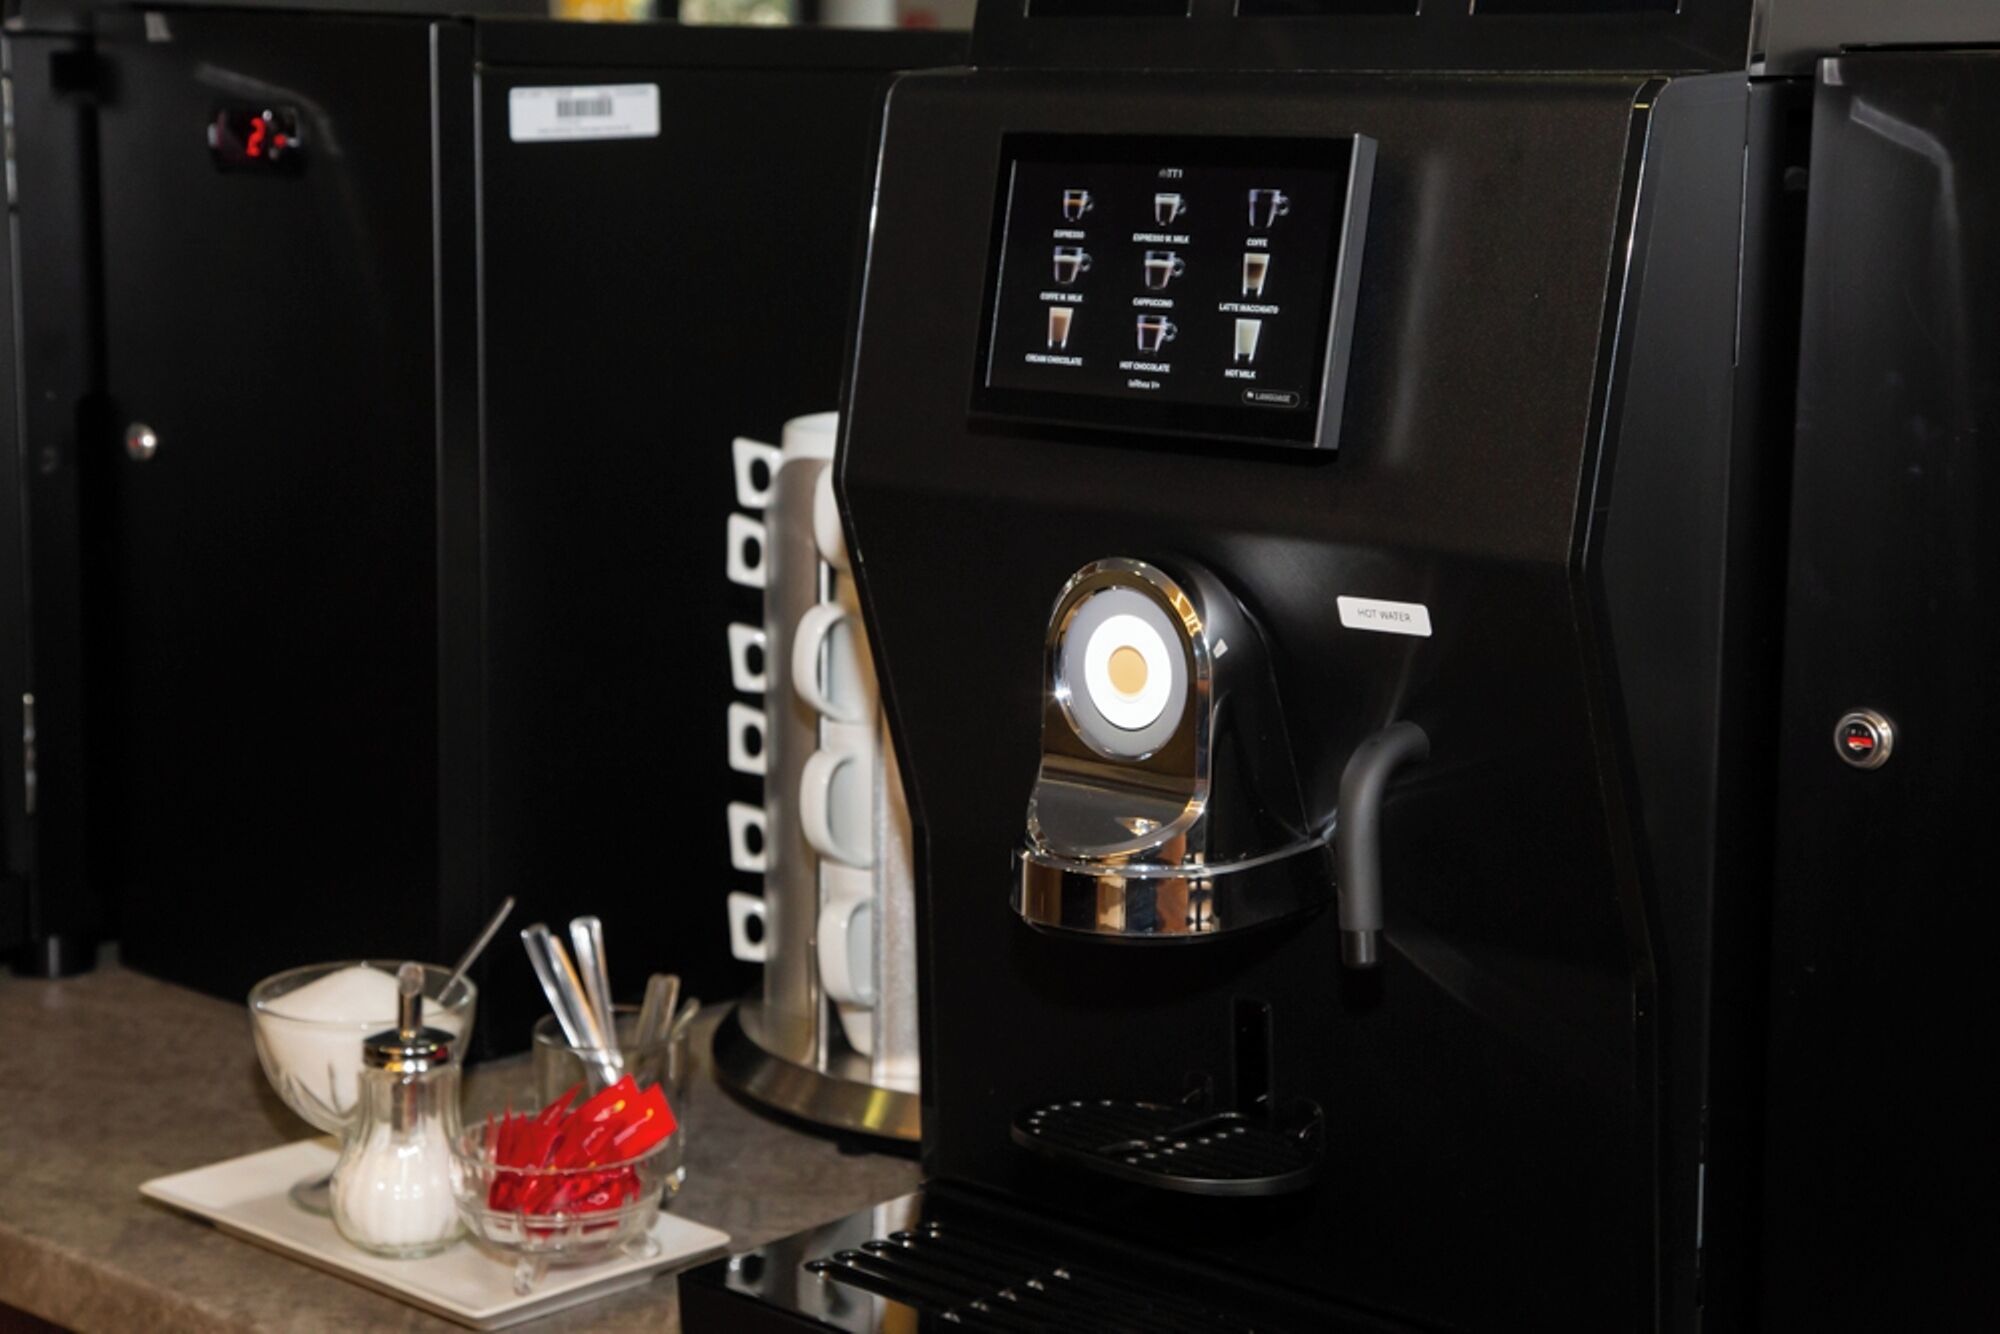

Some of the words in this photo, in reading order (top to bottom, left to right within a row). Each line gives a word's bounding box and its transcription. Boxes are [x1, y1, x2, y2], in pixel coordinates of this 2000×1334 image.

[1053, 229, 1085, 239] ESPRESSO
[1133, 233, 1164, 243] ESPRESSO
[1173, 235, 1190, 244] MILK
[1067, 293, 1083, 303] MILK
[1132, 297, 1174, 308] CAPPUCCINO
[1218, 302, 1239, 312] LATTE
[1240, 303, 1279, 314] MACCHIATO
[1025, 353, 1046, 363] CREAM
[1047, 355, 1083, 366] CHOCOLATE
[1119, 360, 1133, 370] HOT
[1133, 362, 1170, 373] CHOCOLATE
[1224, 369, 1239, 378] HOT
[1239, 370, 1257, 379] MILK
[1255, 392, 1291, 403] LANGUAGE
[1357, 608, 1377, 618] HOT
[1379, 610, 1411, 622] WATER
